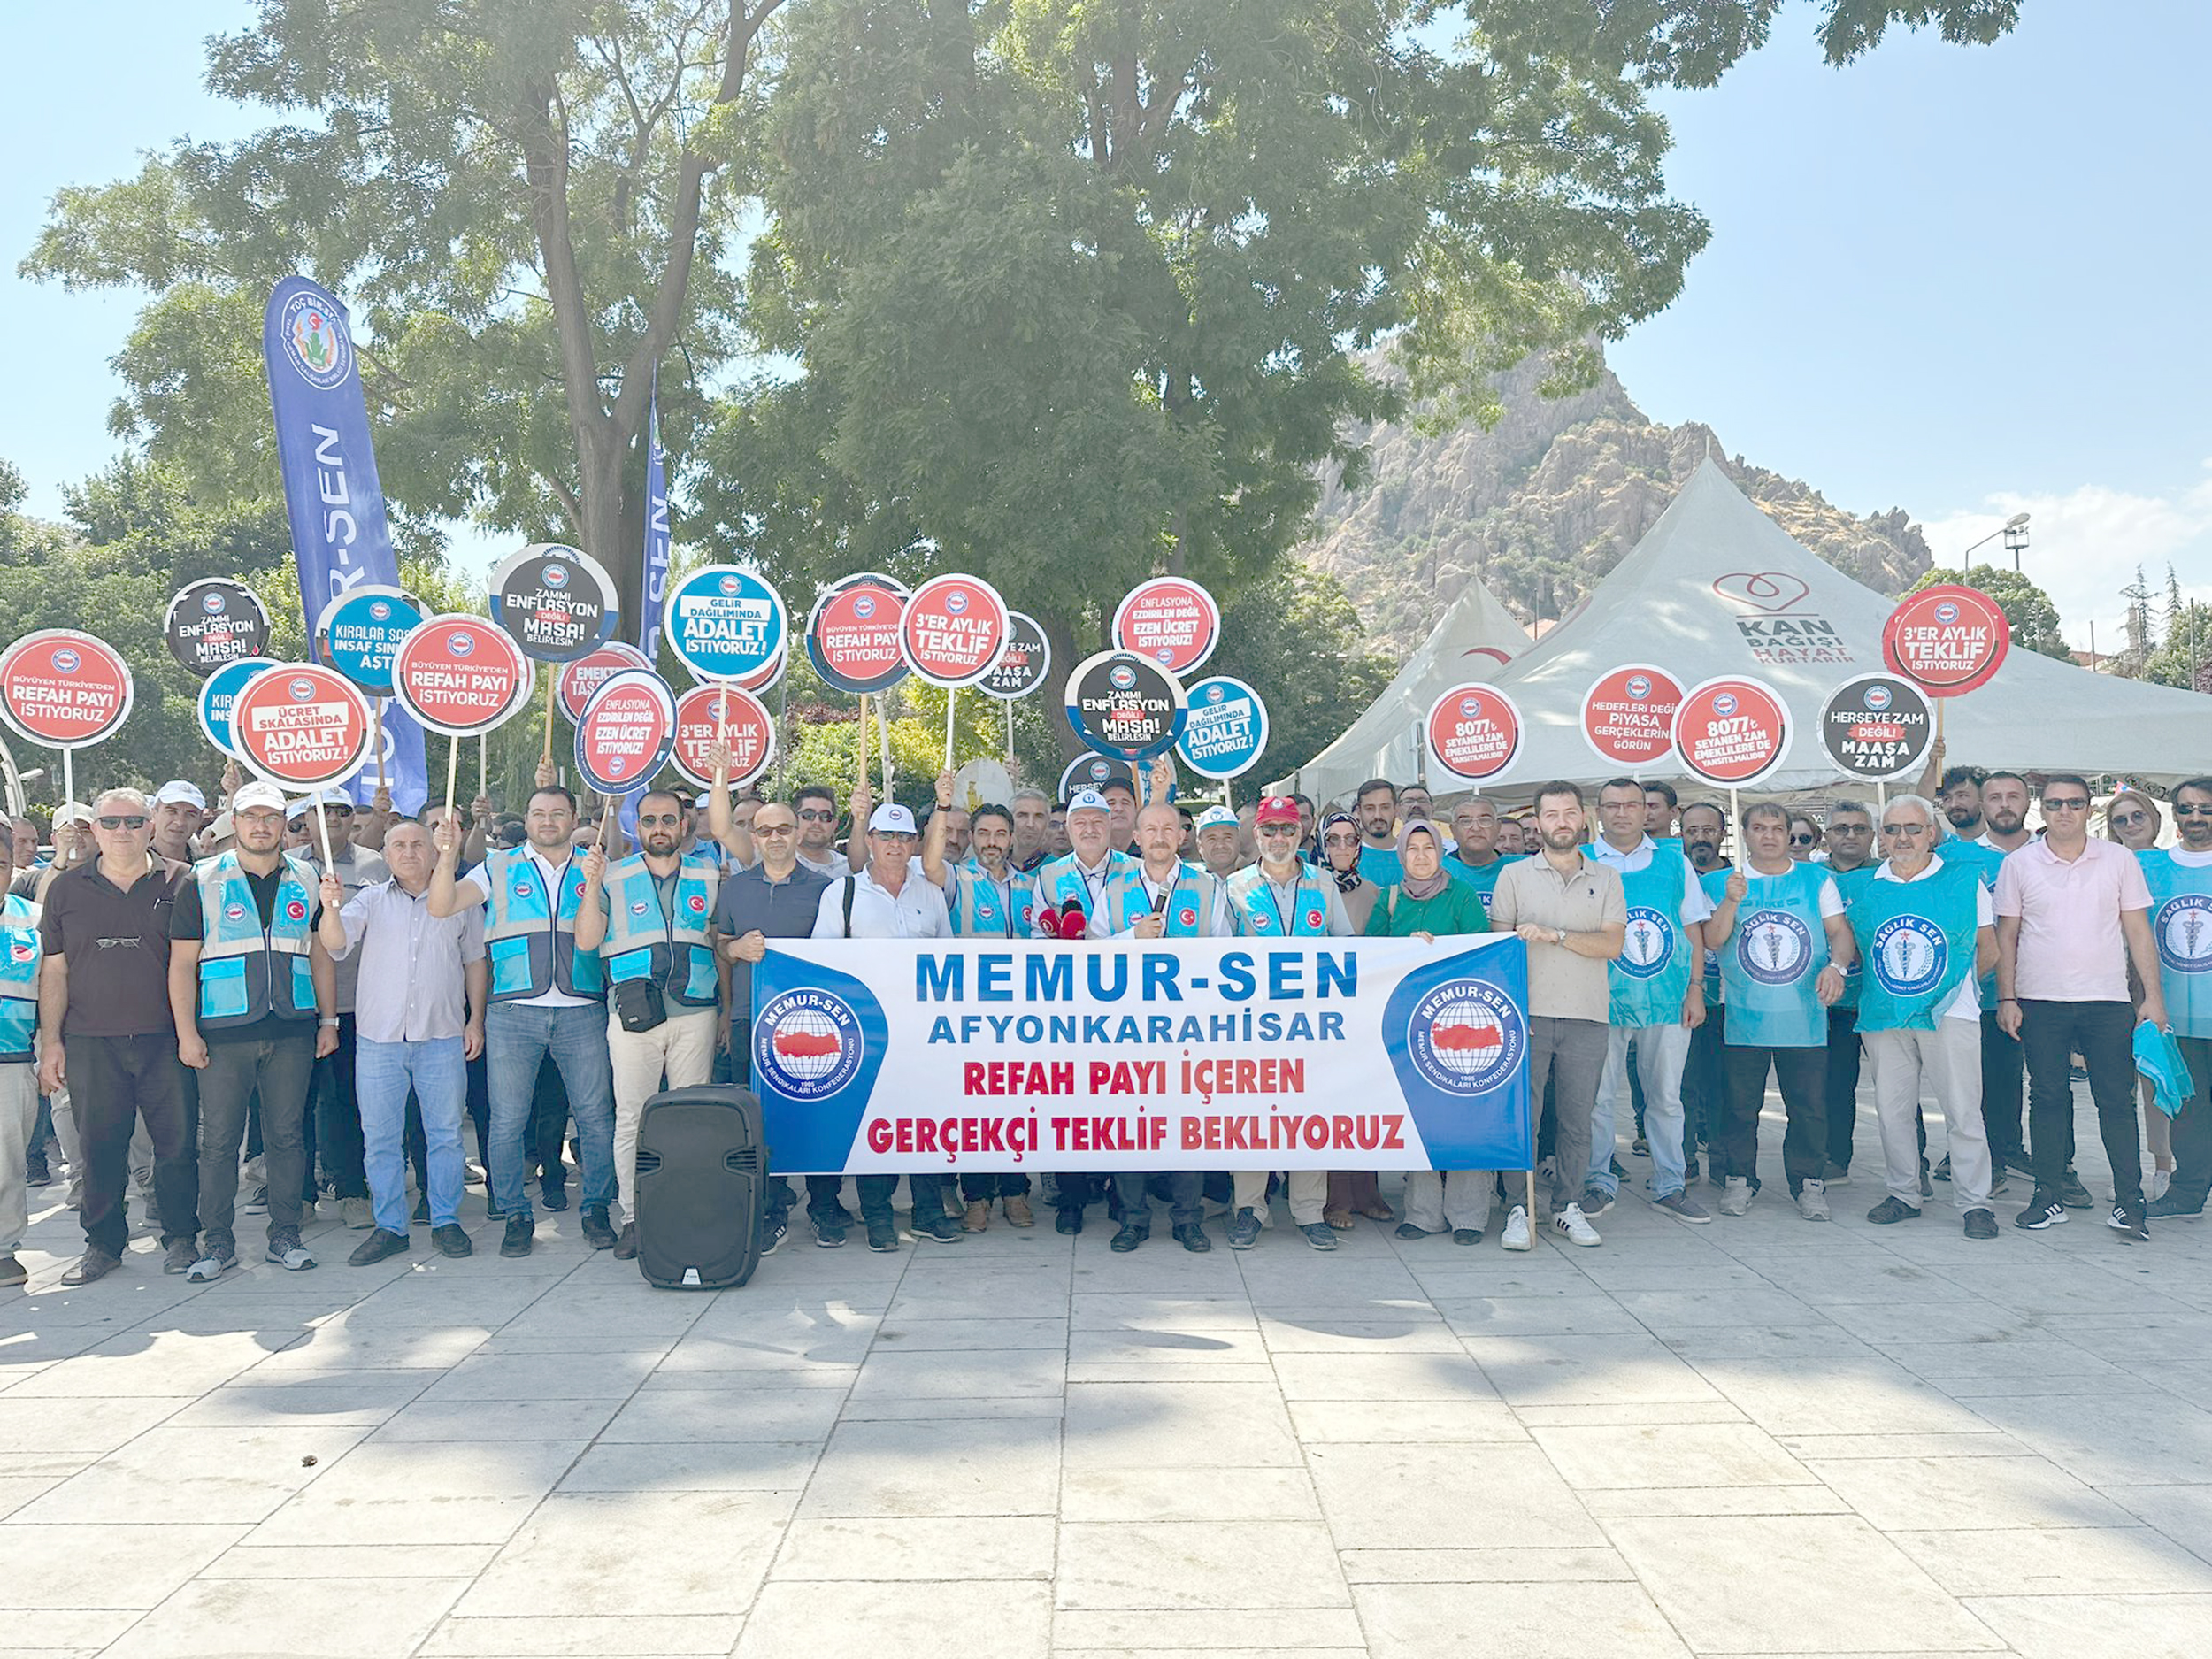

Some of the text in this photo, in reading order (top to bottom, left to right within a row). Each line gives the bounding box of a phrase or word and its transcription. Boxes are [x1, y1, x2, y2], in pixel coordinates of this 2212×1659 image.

[535, 588, 571, 601] ZAMMI
[1141, 597, 1193, 608] ENFLASYONA
[506, 594, 598, 618] ENFLASYON
[710, 599, 741, 608] GELİR
[690, 607, 762, 618] DAĞILIMINDA
[179, 620, 254, 637] ENFLASYON
[524, 618, 585, 641] MASA!
[683, 618, 768, 641] ADALET
[915, 614, 993, 635] 3'ER AYLIK
[1133, 619, 1199, 635] EZEN ÜCRET
[1736, 620, 1836, 637] KAN
[335, 625, 384, 641] KIRALAR
[1903, 626, 1987, 641] 3'ER AYLIK
[196, 638, 247, 657] MASA!
[826, 634, 871, 649] REFAH
[916, 629, 990, 654] TEKLİF
[1018, 643, 1041, 652] ZAM
[1746, 635, 1844, 649] BAĞIŞI
[1753, 647, 1847, 657] HAYAT
[1905, 641, 1985, 659] TEKLİF
[411, 662, 508, 673] BÜYÜYEN TÜRKİYE'DEN
[990, 666, 1032, 678] AAŞA
[13, 675, 115, 690] BÜYÜYEN TÜRKİYE'DEN
[411, 672, 507, 691] REFAH PAYI
[992, 677, 1021, 687] ZAM
[12, 685, 114, 708] REFAH PAYI
[605, 699, 650, 710] ENFLASYONA
[278, 706, 319, 718] ÜCRET
[1082, 699, 1170, 711] ENFLASYON
[1202, 704, 1227, 717] GELİR
[1592, 702, 1678, 714] HEDEFLERİ DEĞİ
[259, 714, 342, 729] SKALASINDA
[1102, 718, 1160, 733] MASA!
[1189, 709, 1244, 729] DAĞILIMINDA
[1609, 713, 1659, 727] PİYASA
[1831, 711, 1924, 725] HERŞEYE ZAM
[264, 727, 347, 751] ADALET
[595, 724, 652, 740] EZEN ÜCRET
[680, 725, 713, 738] 3'ER
[1188, 718, 1251, 749] ADALET
[683, 739, 757, 757] TELİF
[1446, 732, 1504, 748] SEYANEN ZAM
[1496, 741, 1508, 750] DE
[1613, 740, 1651, 750] GÖRÜN
[1694, 730, 1767, 750] SEYANEN ZAM
[1756, 740, 1771, 750] DE
[1841, 741, 1909, 757] MAAŞA
[1855, 755, 1895, 768] ZAM
[1650, 913, 1669, 932] SEN
[1783, 917, 1806, 935] SEN
[1919, 923, 1942, 946] SEN
[915, 950, 1357, 1002] MEMUR-SEN
[764, 995, 850, 1026] MEMUR-SEN
[1421, 986, 1511, 1019] MEMUR-SEN
[927, 1007, 1346, 1044] AFYONKARAHİSAR
[761, 1037, 771, 1067] MEMUR
[812, 1037, 855, 1094] KONFEDERASYONU
[1418, 1030, 1428, 1062] MEMUR
[1472, 1029, 1517, 1088] KONFEDERASYONU
[964, 1049, 1305, 1104] REFAH PAYI İÇEREN
[867, 1104, 1405, 1163] GERÇEKÇİ TEKLİF BEKLİYORUZ
